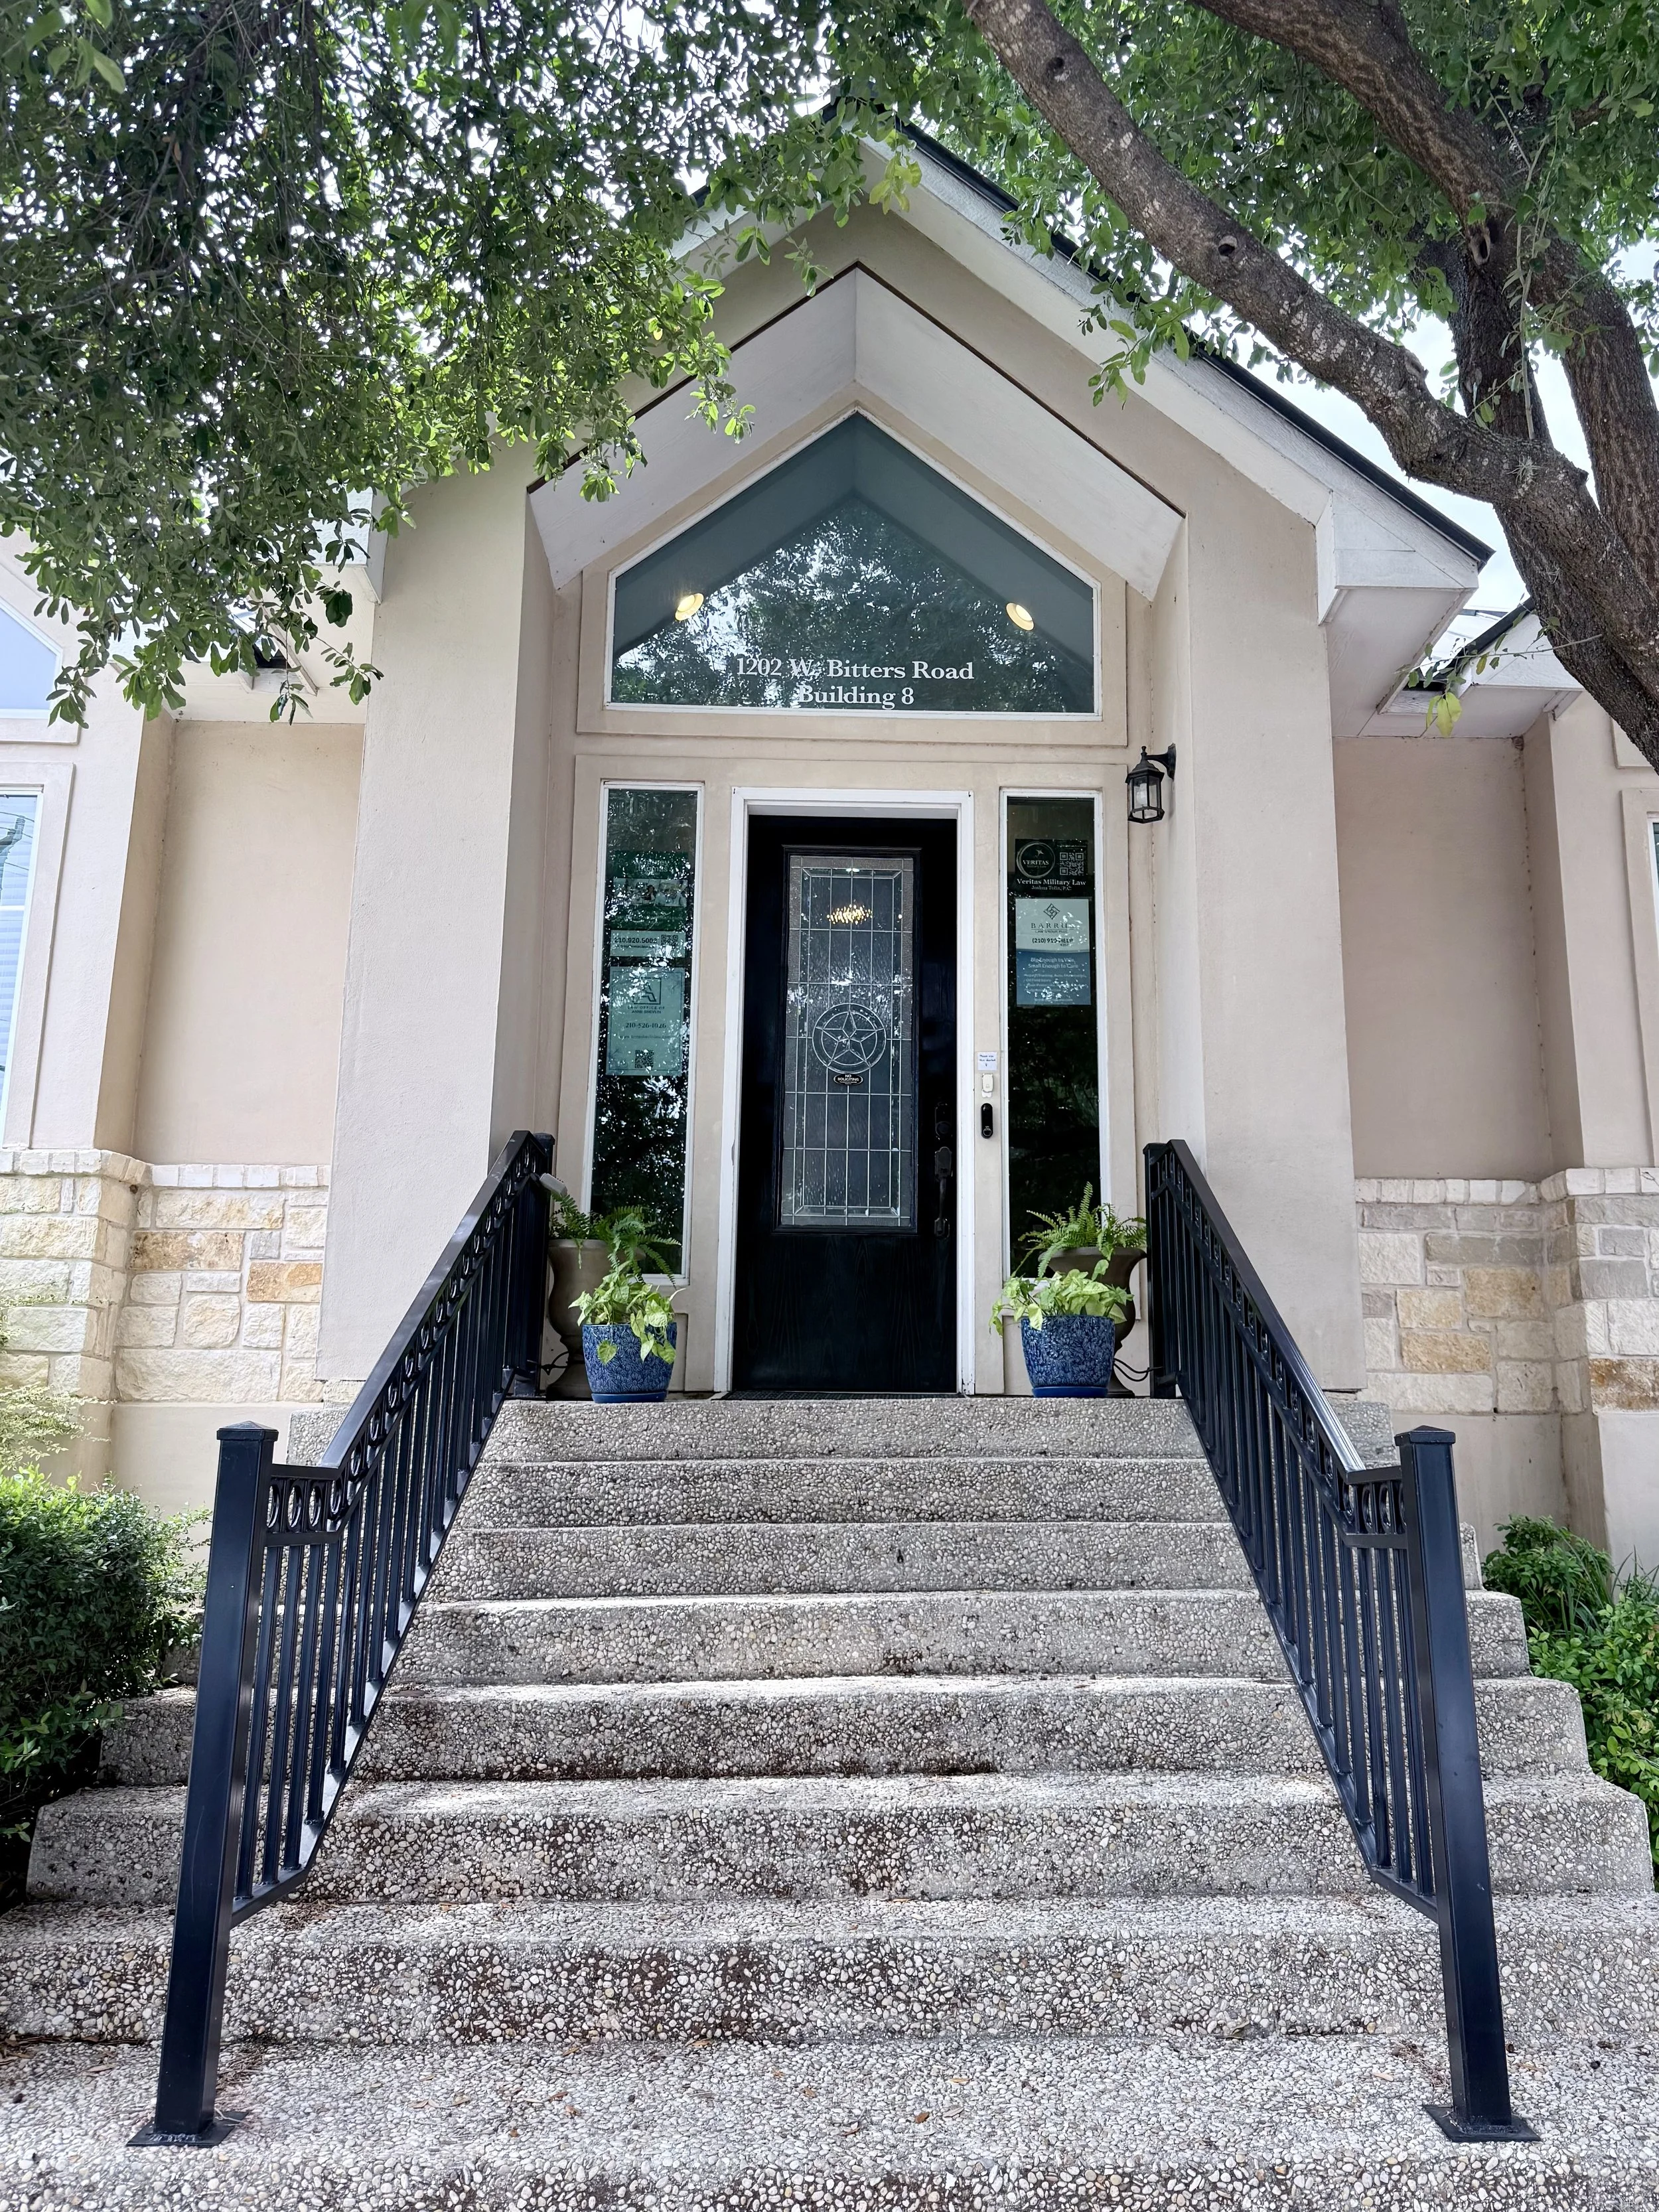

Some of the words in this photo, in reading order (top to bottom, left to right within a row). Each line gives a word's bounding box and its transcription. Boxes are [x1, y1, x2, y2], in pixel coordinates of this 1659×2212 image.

[737, 657, 782, 676] 1202
[826, 659, 906, 679] Bitters
[912, 661, 975, 680] Road
[798, 685, 897, 710] Building
[901, 687, 914, 705] 8
